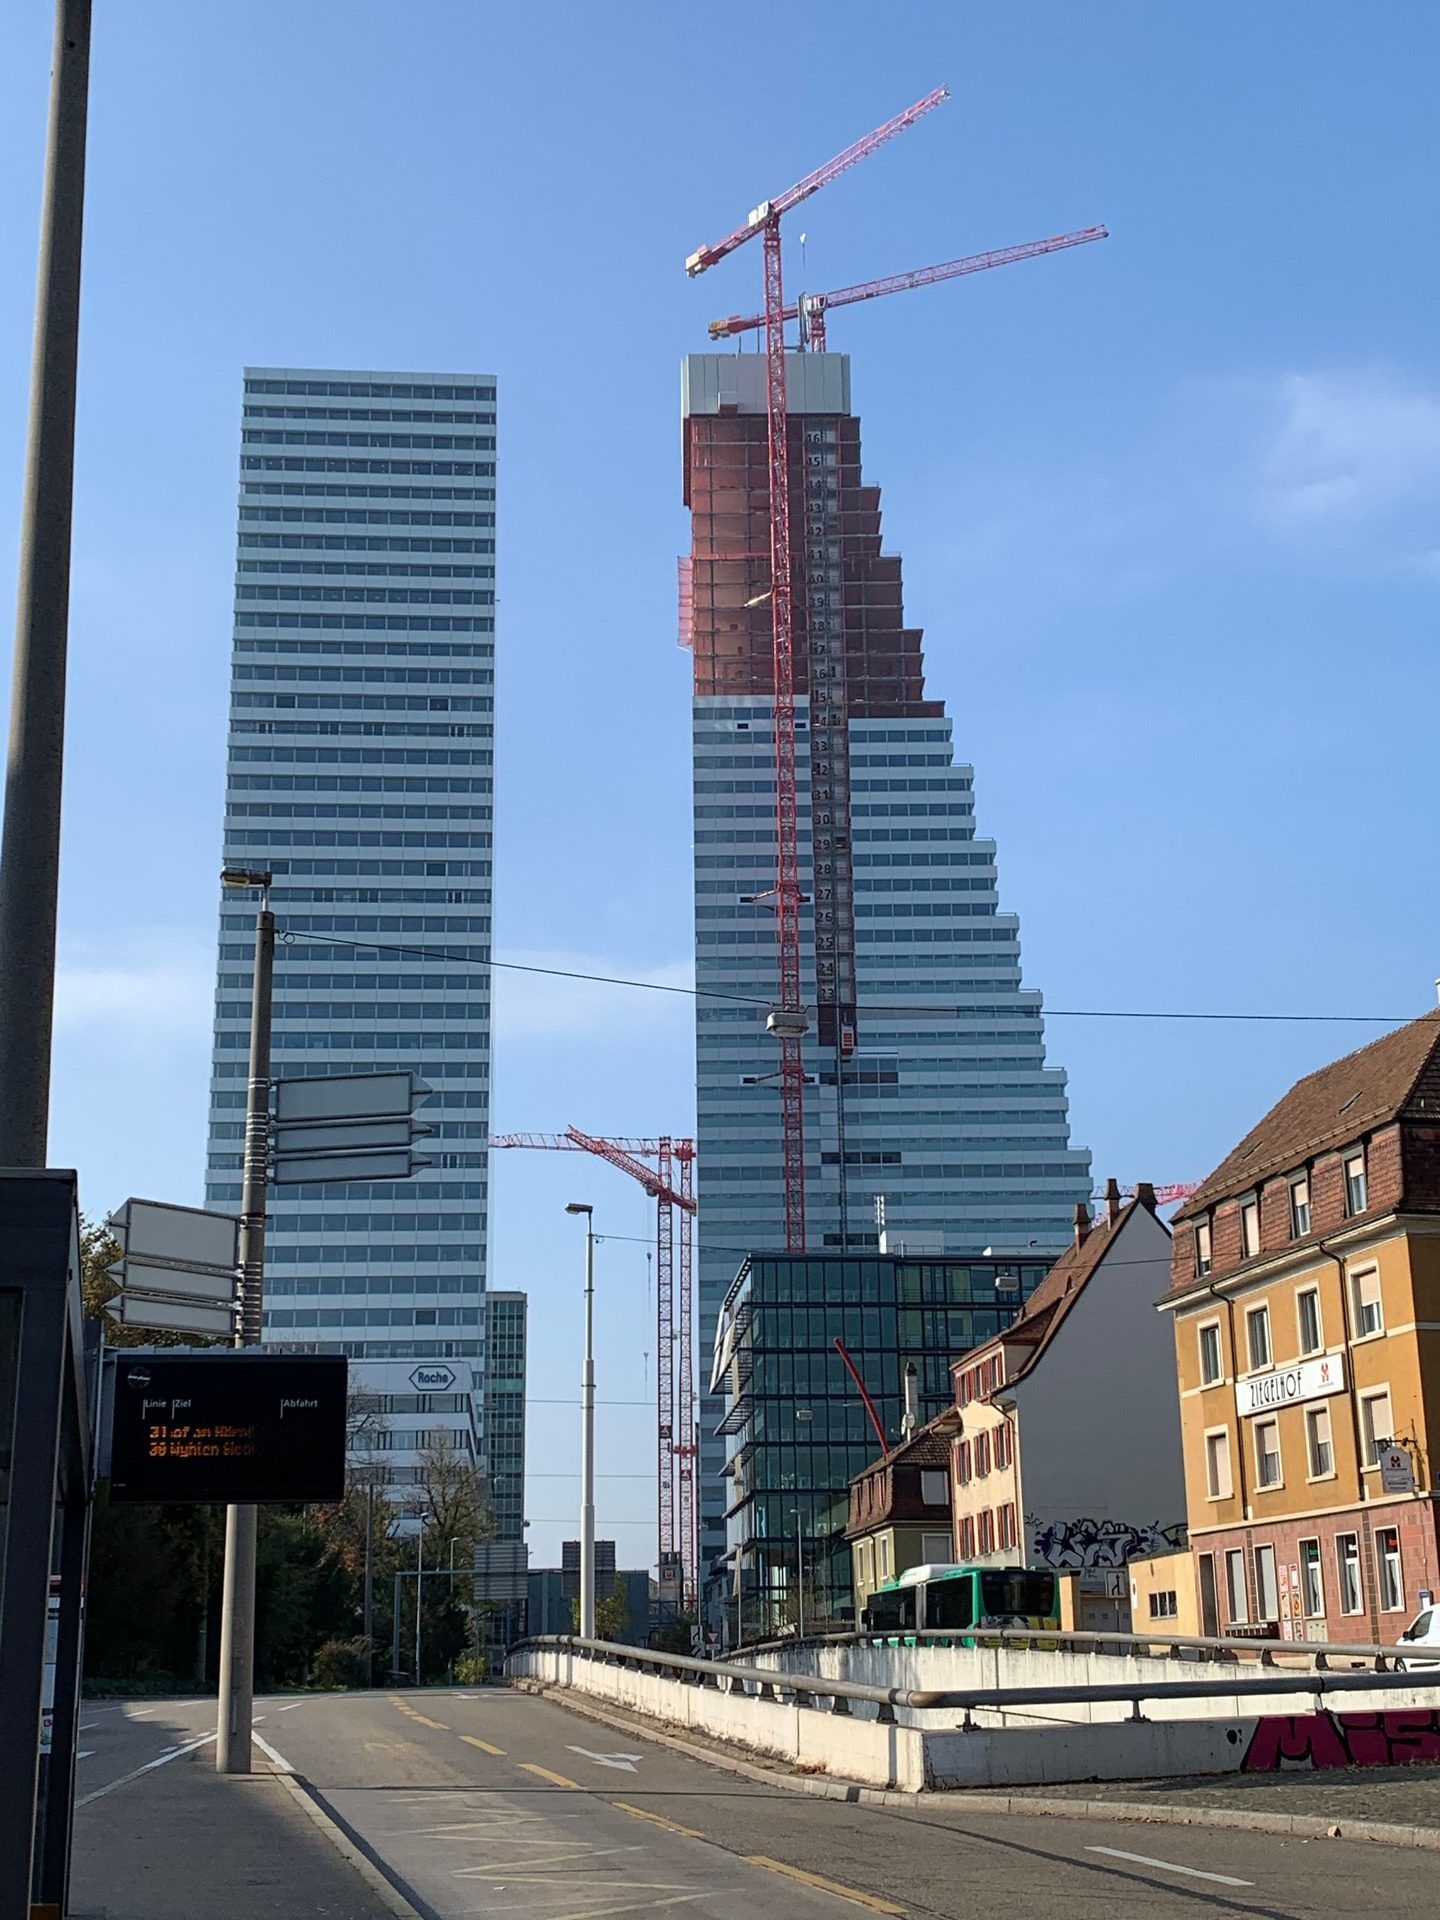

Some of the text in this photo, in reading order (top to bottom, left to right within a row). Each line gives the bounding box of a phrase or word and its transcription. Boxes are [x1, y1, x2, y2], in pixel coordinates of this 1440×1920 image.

[814, 740, 828, 751] 33
[814, 789, 828, 800] 31
[814, 814, 830, 825] 30
[814, 839, 830, 850] 29
[816, 863, 831, 875] 28
[816, 888, 831, 900] 27
[816, 911, 833, 922] 26
[816, 937, 833, 949] 25
[819, 962, 834, 974] 24
[418, 1371, 448, 1384] Roche
[1250, 1371, 1301, 1407] ZIEGELHOF
[145, 1399, 319, 1408] Linie Ziel Abfahrt
[149, 1425, 167, 1438] 31
